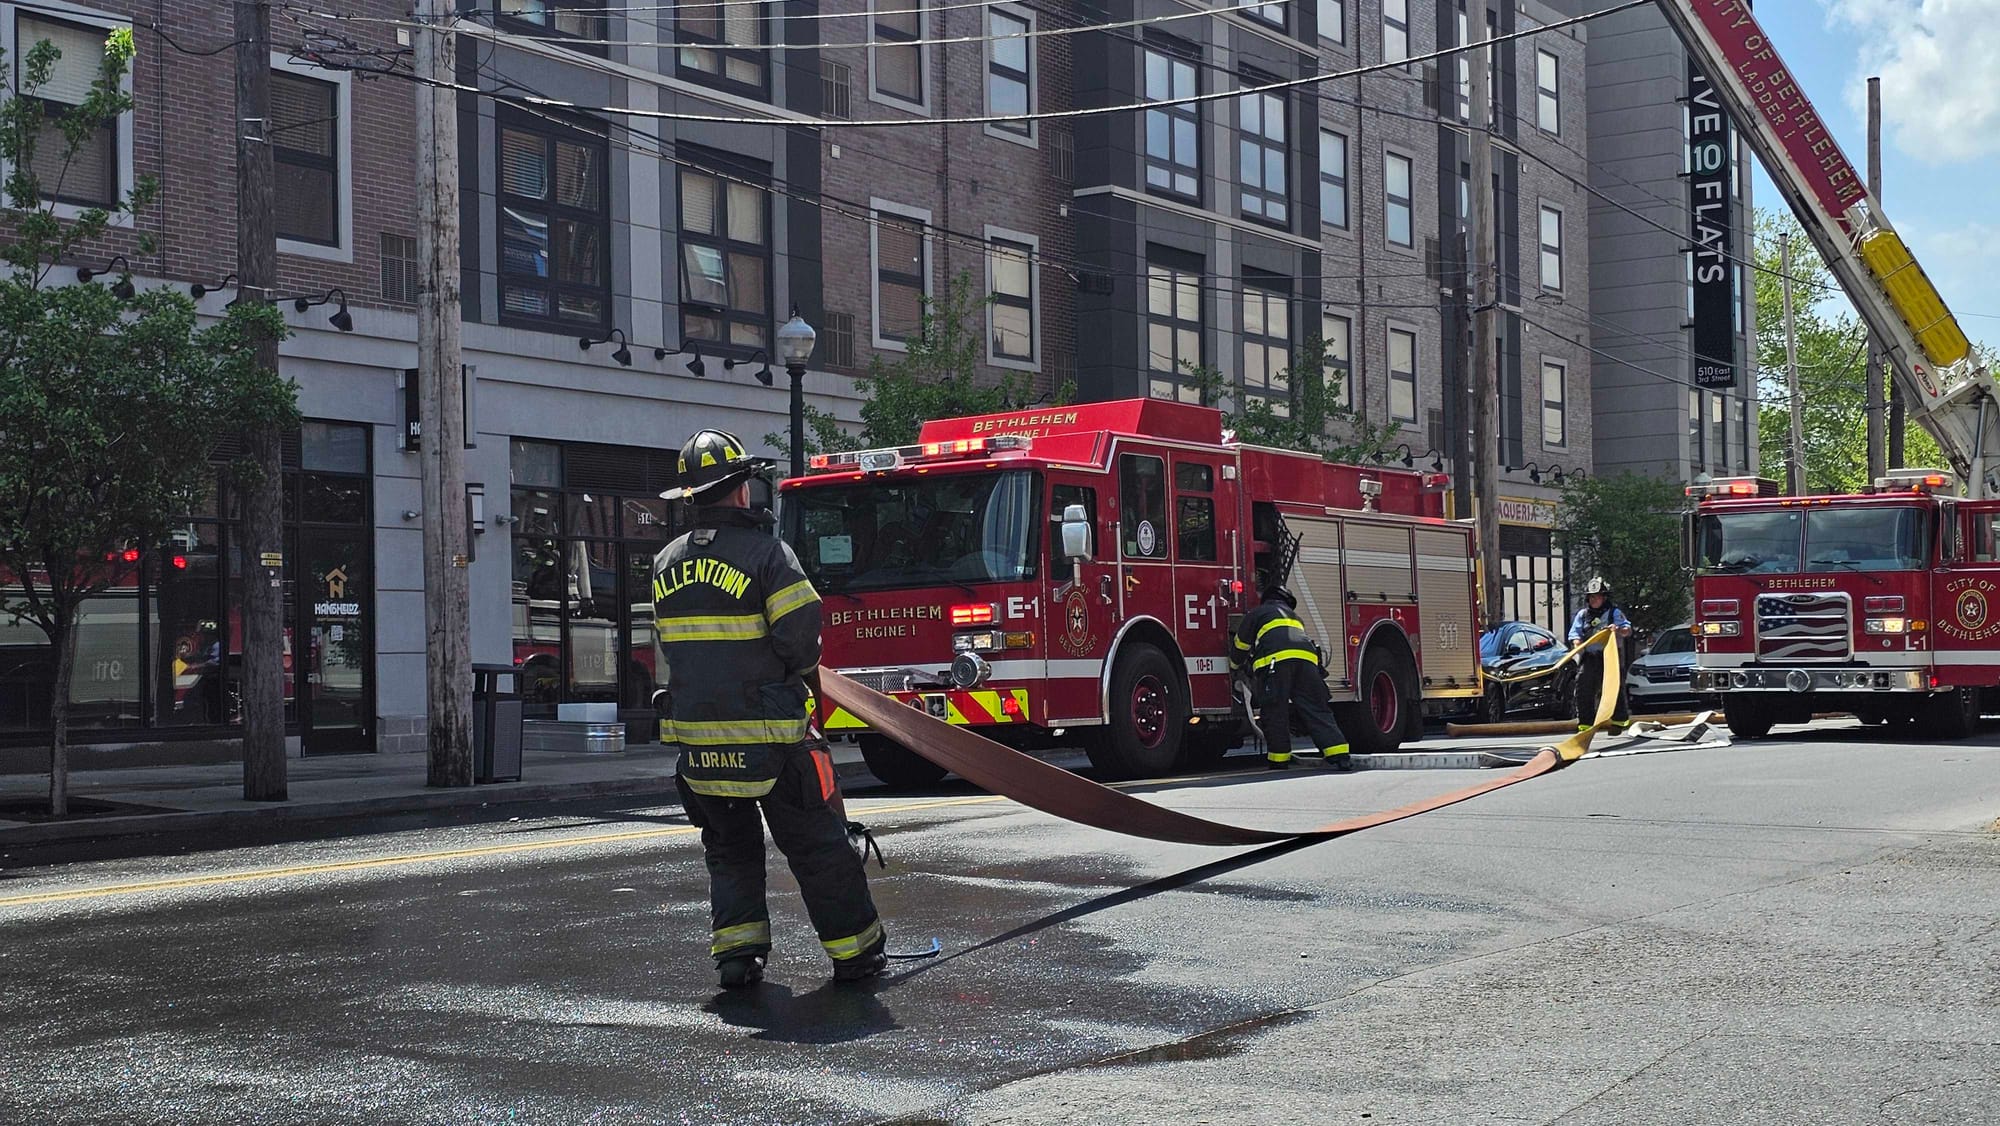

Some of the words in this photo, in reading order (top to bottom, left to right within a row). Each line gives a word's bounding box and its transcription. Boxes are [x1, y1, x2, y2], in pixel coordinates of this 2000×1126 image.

[1713, 0, 1750, 28] ITY
[1744, 35, 1773, 61] OF
[1767, 70, 1861, 204] BETHLEHEM
[1739, 61, 1786, 125] LADDER
[1693, 144, 1721, 171] 10
[1696, 181, 1725, 283] FLATS
[1697, 366, 1713, 376] 510
[1714, 367, 1730, 375] East
[973, 412, 1078, 433] BETHLEHEM
[1498, 502, 1536, 521] AQUERIA
[653, 558, 752, 603] ALLENTOWN
[1768, 578, 1836, 589] BETHLEHEM
[1946, 578, 1974, 592] CITY
[1979, 580, 1997, 592] OF
[831, 605, 942, 626] BETHLEHEM
[1007, 596, 1039, 619] E-1
[1185, 594, 1217, 629] E-1
[856, 625, 906, 639] ENGINE
[1440, 622, 1457, 649] 911
[1937, 619, 2000, 641] BETHLEHE
[1905, 635, 1926, 650] L-1
[1196, 659, 1214, 671] 10-E1
[688, 752, 699, 768] A.
[701, 752, 747, 768] DRAKE
